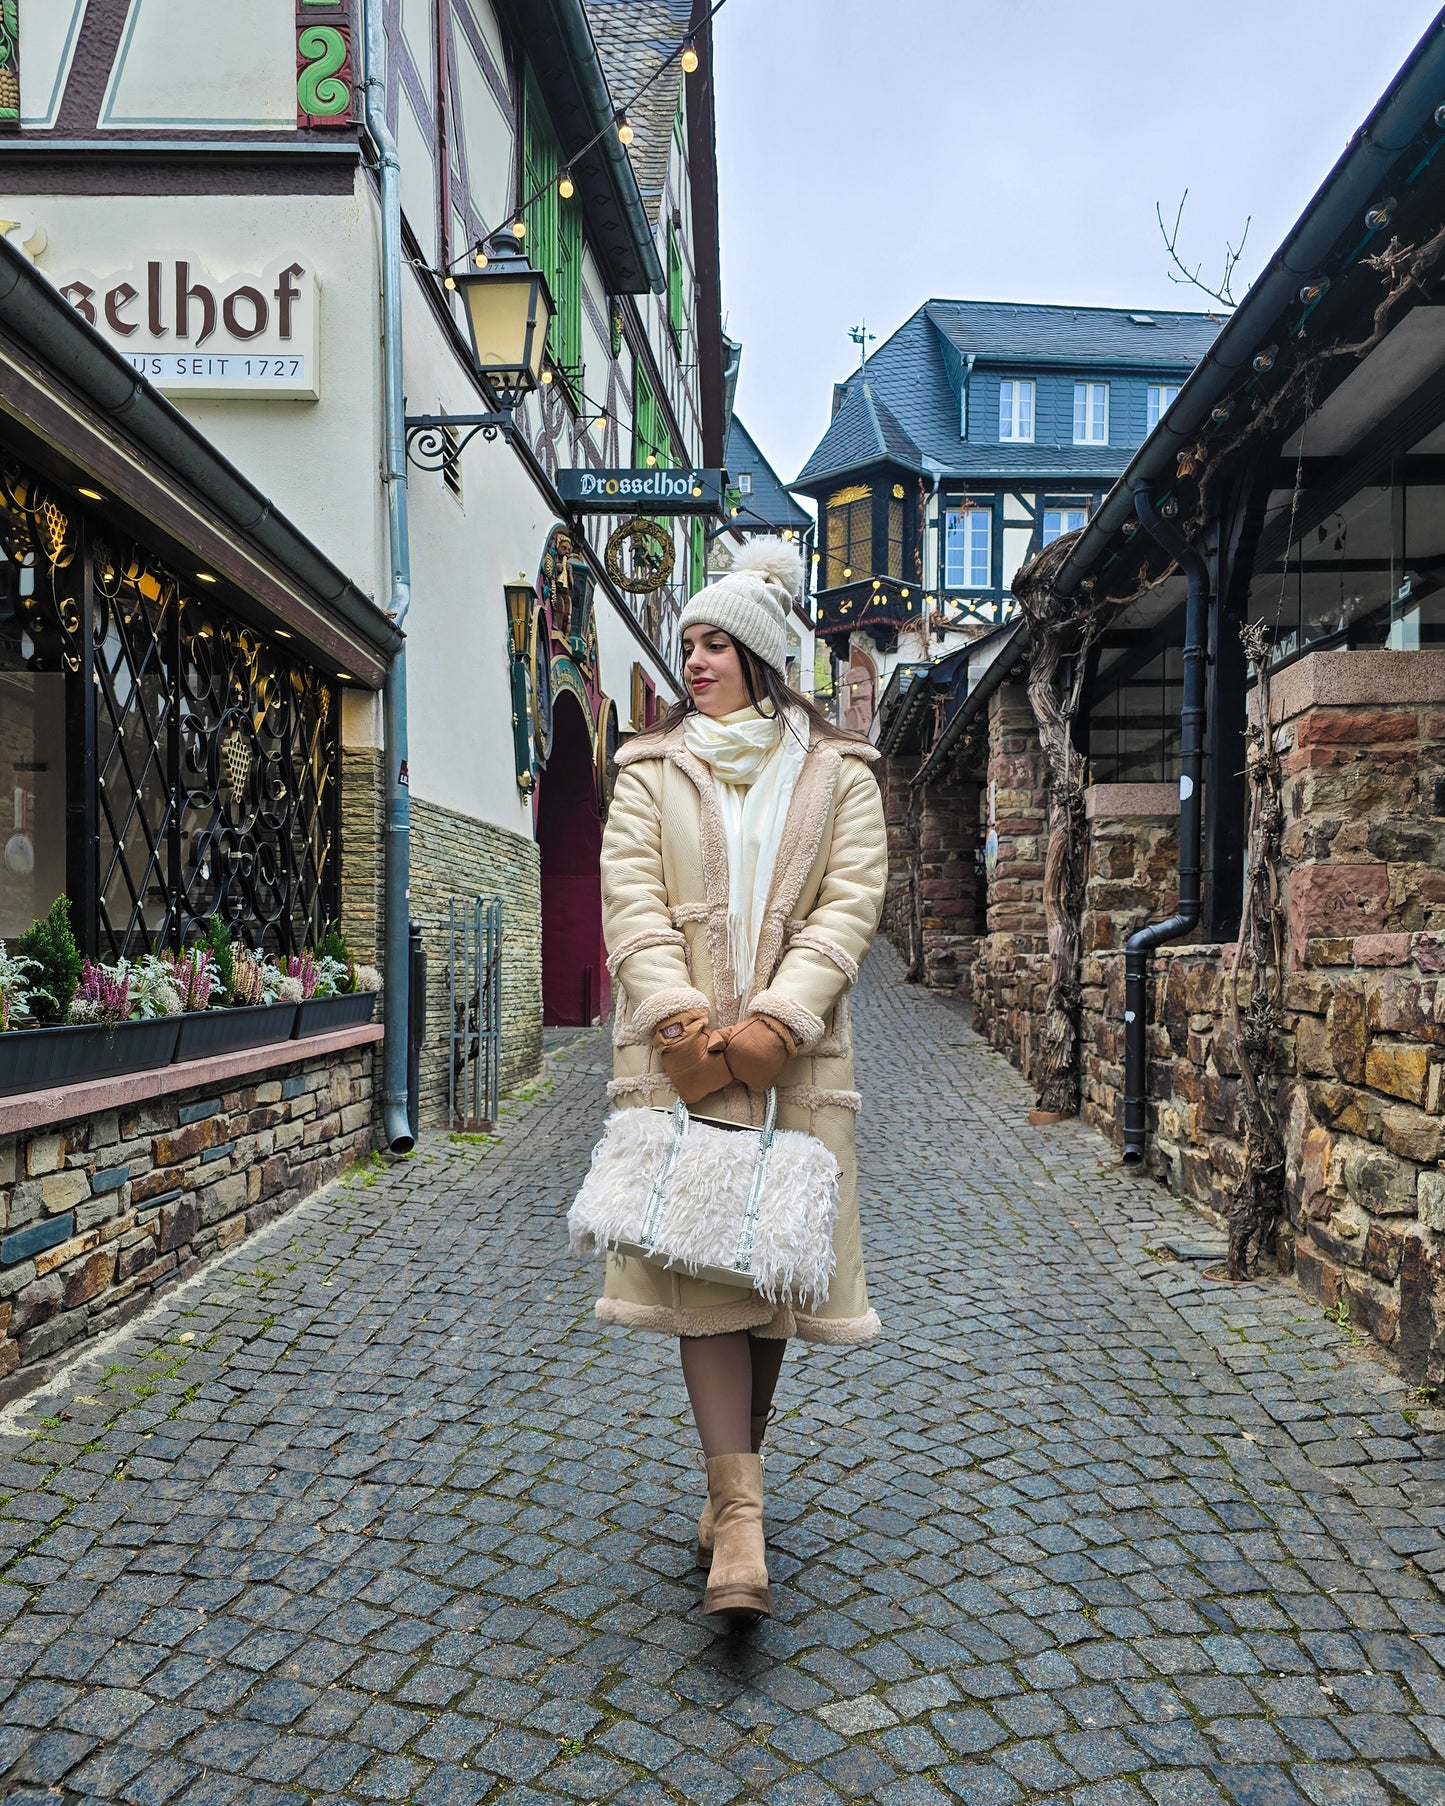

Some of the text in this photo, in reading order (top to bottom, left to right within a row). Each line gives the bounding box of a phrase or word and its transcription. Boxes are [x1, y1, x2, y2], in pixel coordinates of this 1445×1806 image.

[176, 358, 229, 375] SEIT
[244, 360, 300, 377] 1727
[580, 472, 698, 497] Drosselhof
